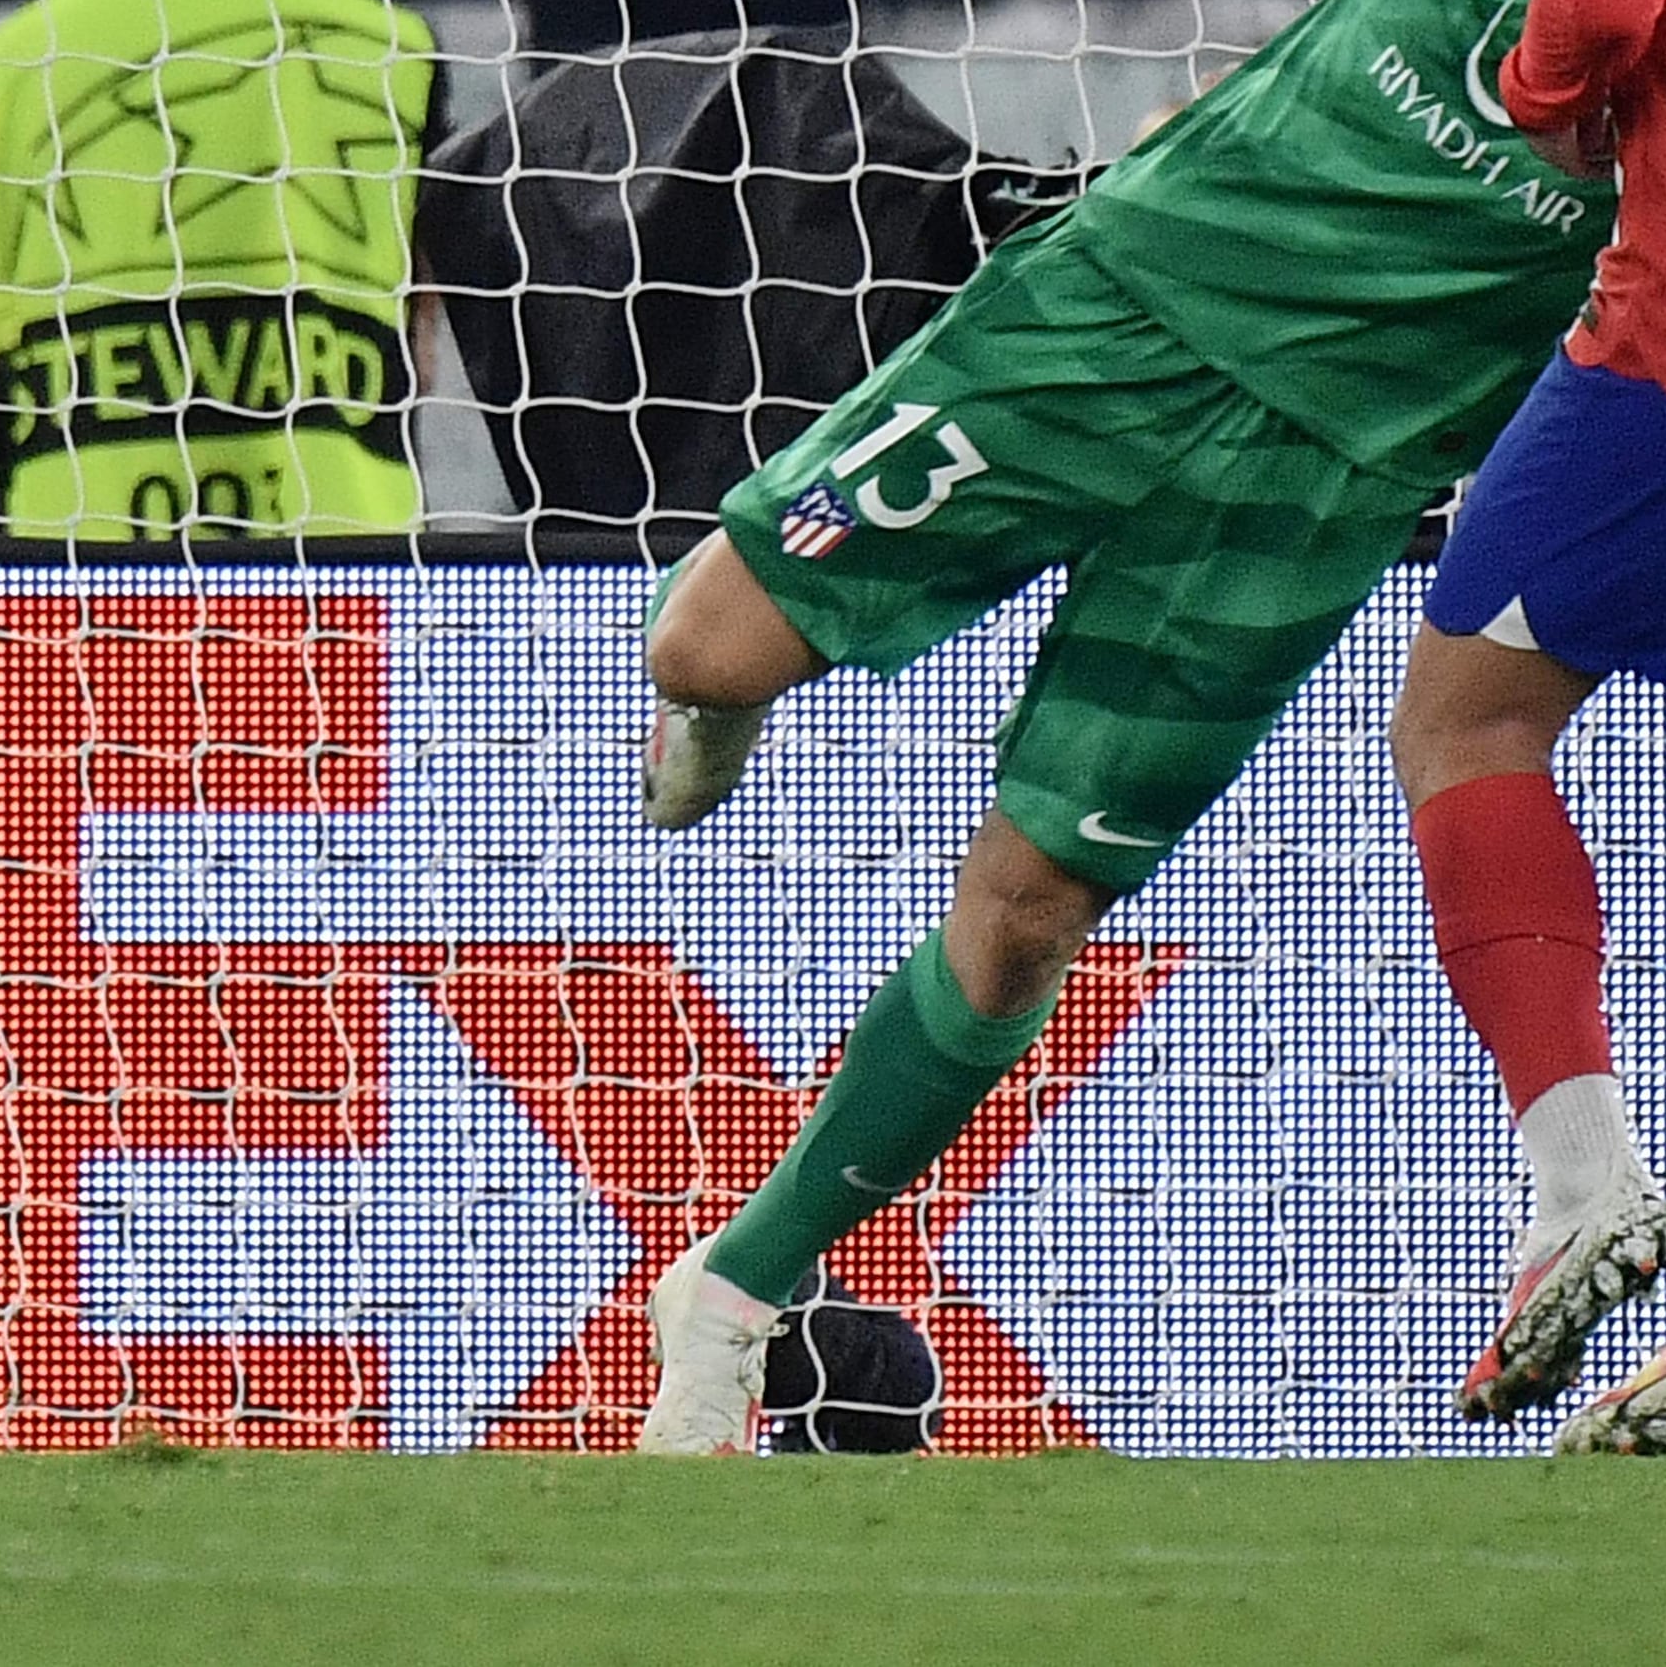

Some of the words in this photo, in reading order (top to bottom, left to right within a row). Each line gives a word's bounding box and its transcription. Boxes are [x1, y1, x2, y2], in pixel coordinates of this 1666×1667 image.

[1367, 44, 1510, 186] RIYADH
[1501, 178, 1585, 234] AIR
[829, 403, 991, 530] 13
